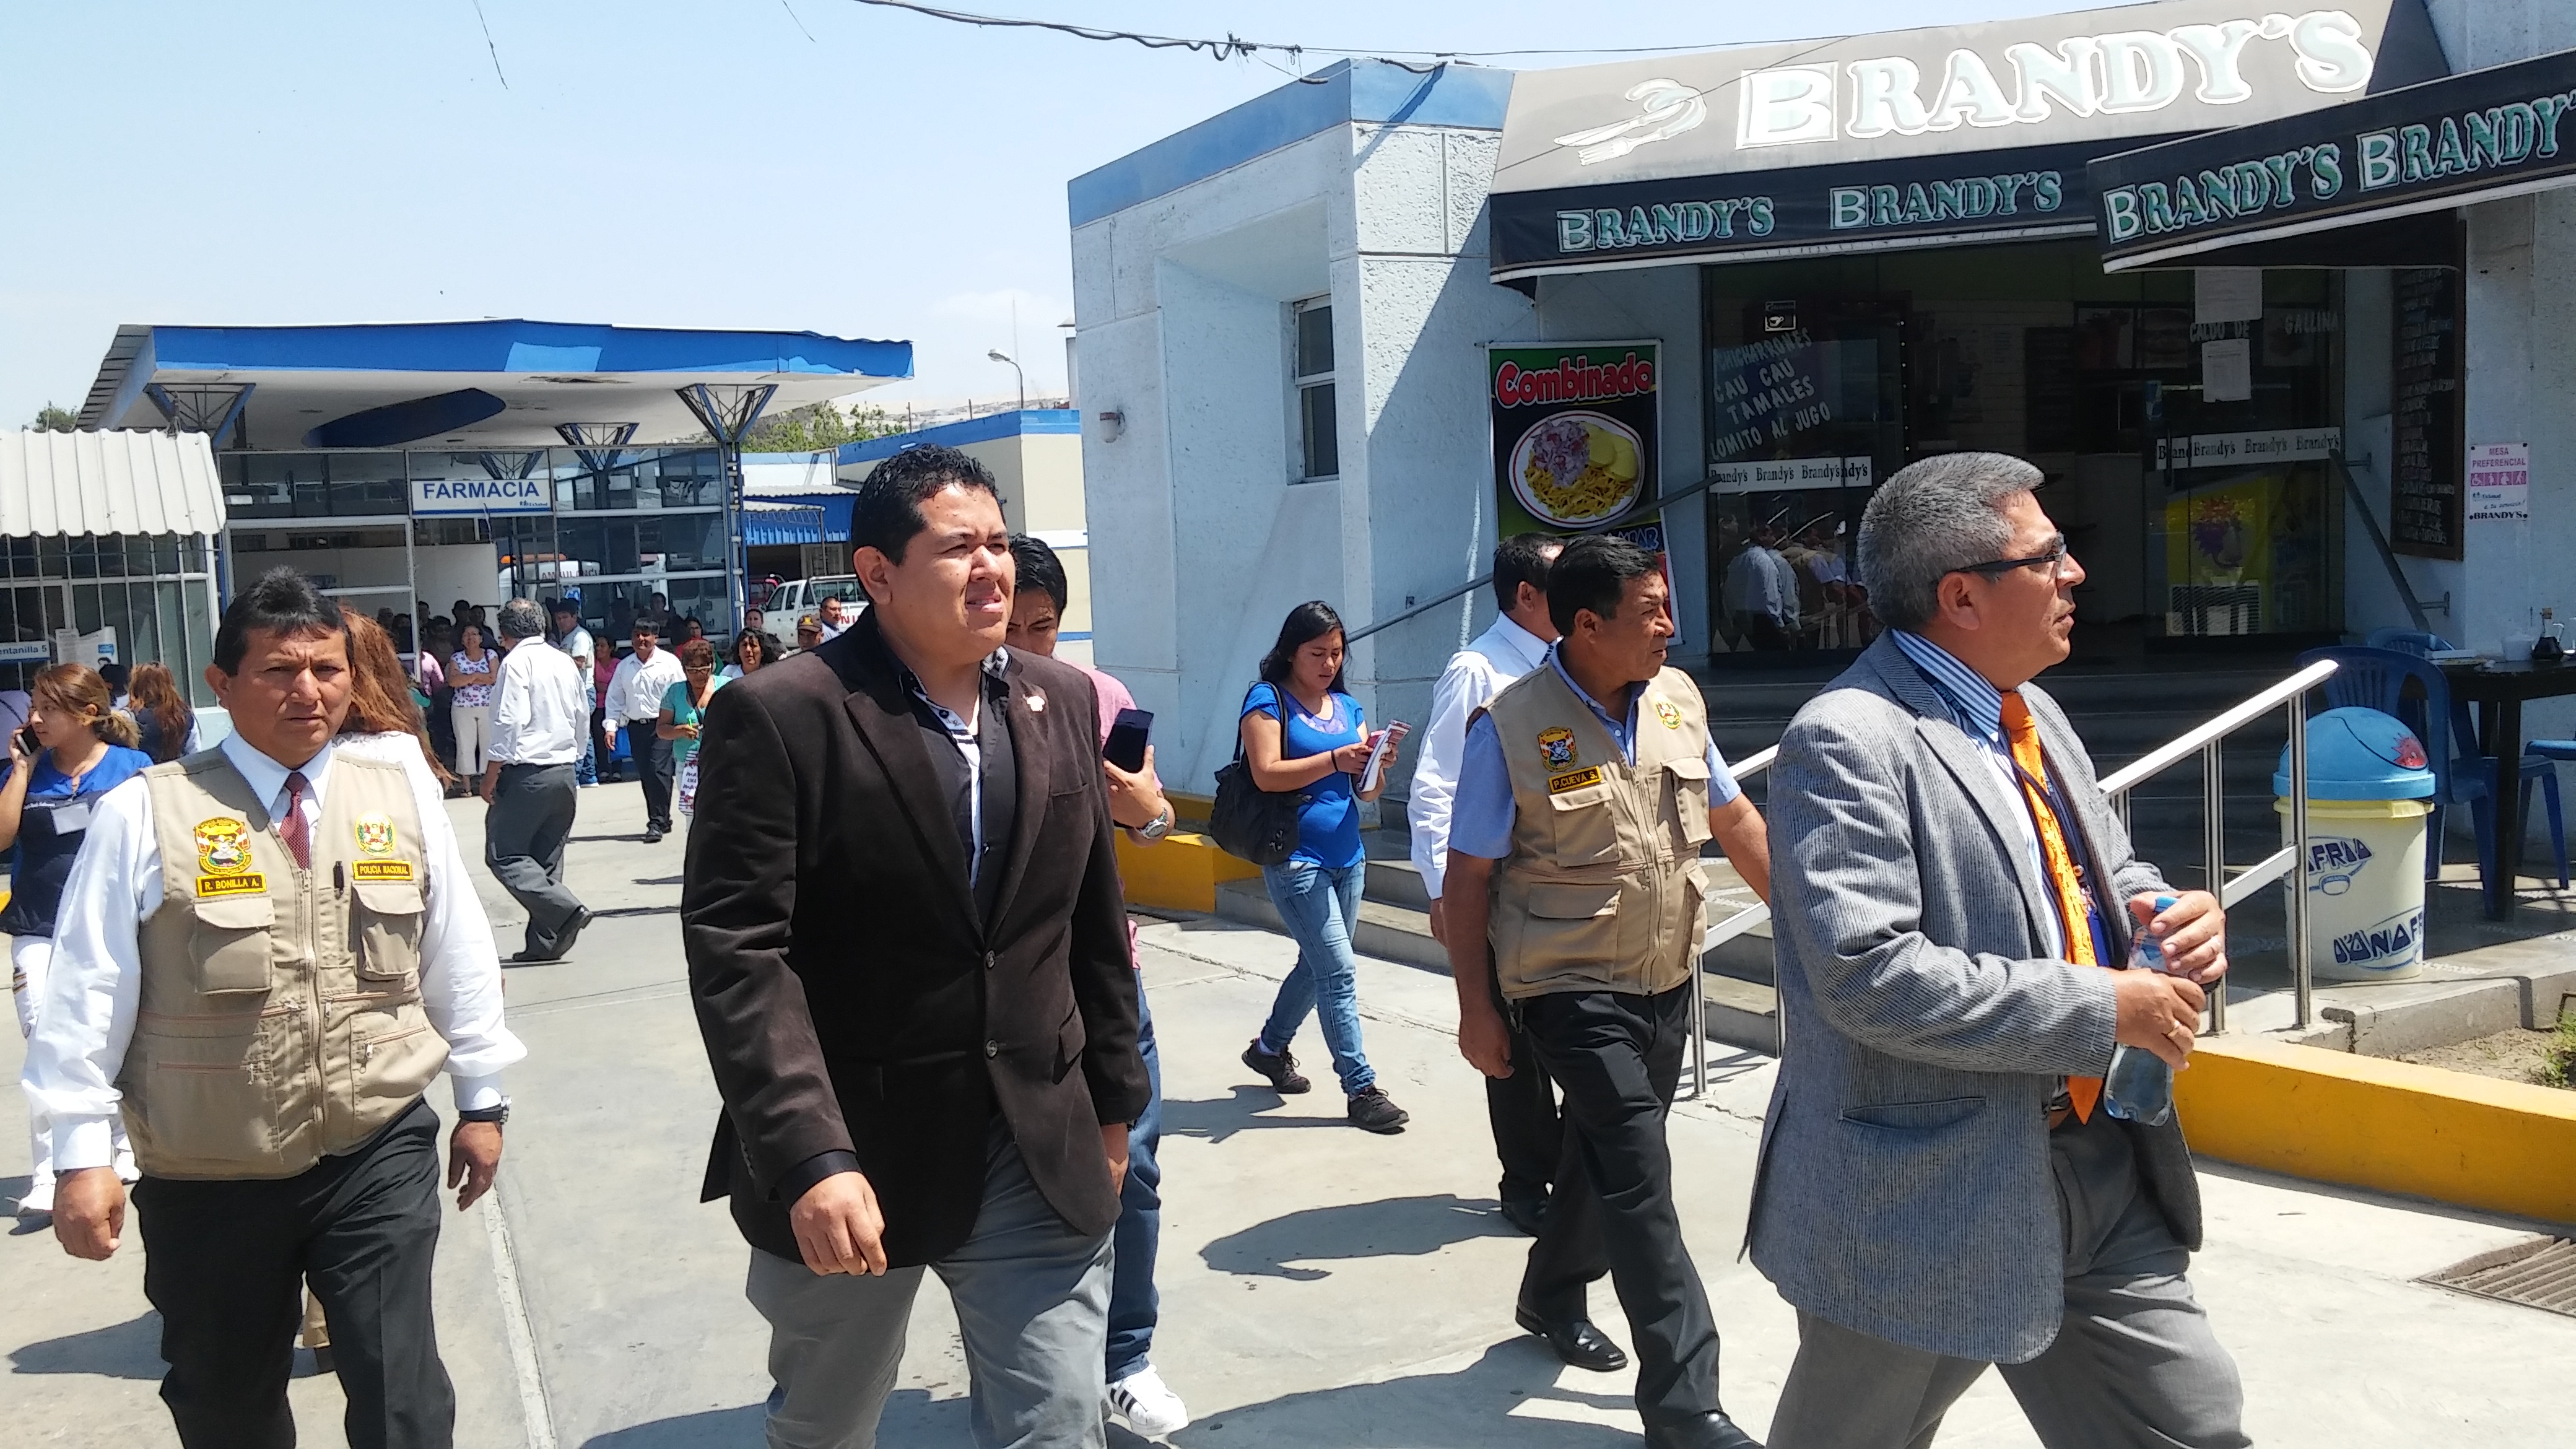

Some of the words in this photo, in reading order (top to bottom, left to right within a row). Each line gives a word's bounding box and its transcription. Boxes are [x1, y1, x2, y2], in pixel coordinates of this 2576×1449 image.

[1735, 11, 2375, 149] BRANDY'S
[2104, 143, 2343, 243] BRANDY'S
[2357, 89, 2576, 192] BRANDY'
[1557, 196, 1775, 253] BRANDY'S
[1830, 170, 2063, 230] BRANDY'S
[2285, 311, 2338, 335] GALLINA
[1495, 352, 1653, 409] Combinado
[1713, 374, 1749, 404] CAU
[1759, 357, 1796, 388] CAU
[1726, 375, 1815, 425] TAMALES
[1710, 426, 1763, 461] LOMITO
[1771, 417, 1789, 439] AL
[1795, 401, 1831, 432] JUGO
[2194, 440, 2235, 459] Brandy's
[2245, 437, 2287, 456] Brandy's
[2489, 447, 2509, 455] MESA
[1756, 466, 1795, 484] Brandy's
[1802, 463, 1840, 482] Brandy's
[2473, 458, 2526, 468] PREFERENCIAL
[423, 481, 539, 499] FARMACIA
[2474, 511, 2522, 519] BRANDY'S
[0, 645, 38, 655] entanilla
[1554, 773, 1588, 789] P.CUEVA
[1590, 771, 1598, 780] S.
[359, 865, 381, 874] POLICIA
[383, 866, 408, 874] NACIONAL
[205, 881, 213, 890] R.
[215, 878, 248, 889] BONILLA
[251, 879, 259, 887] A.
